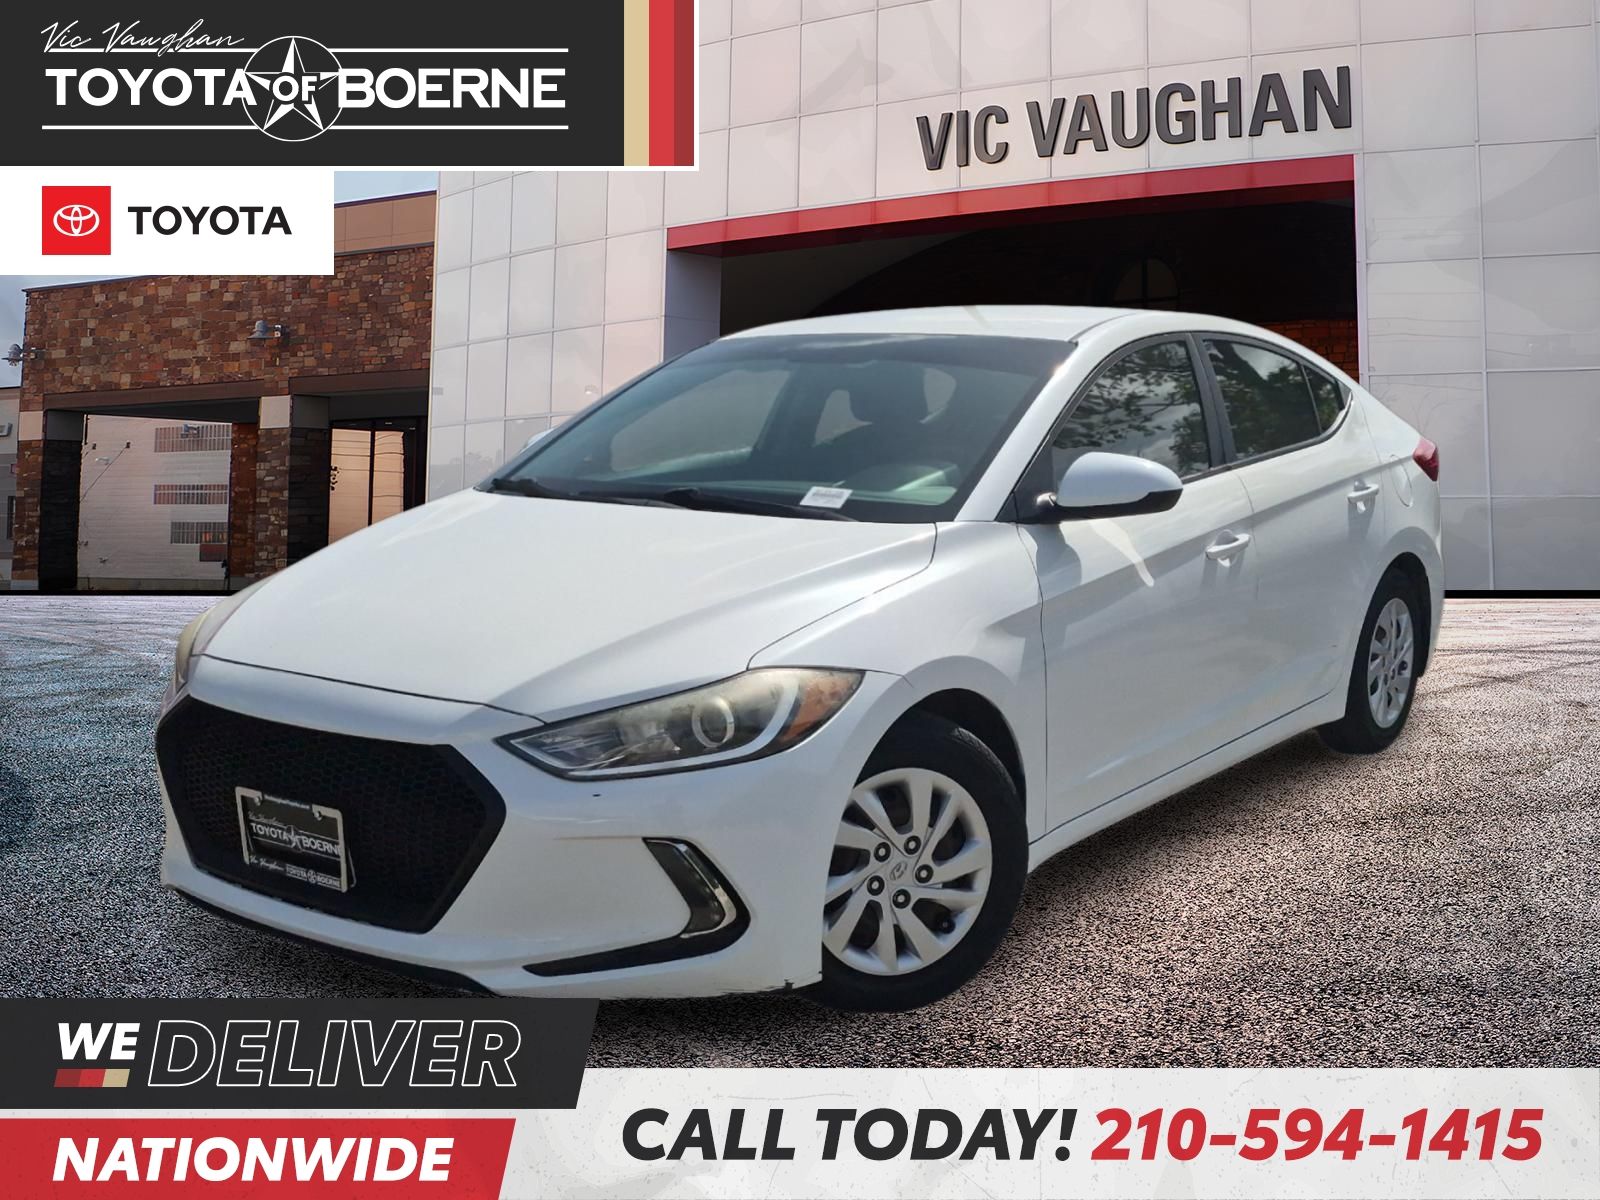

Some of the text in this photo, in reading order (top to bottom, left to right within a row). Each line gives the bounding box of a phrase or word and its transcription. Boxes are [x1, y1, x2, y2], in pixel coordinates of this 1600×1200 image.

[916, 65, 1352, 171] VIC VAUGHAN
[250, 822, 290, 842] TOYOTA
